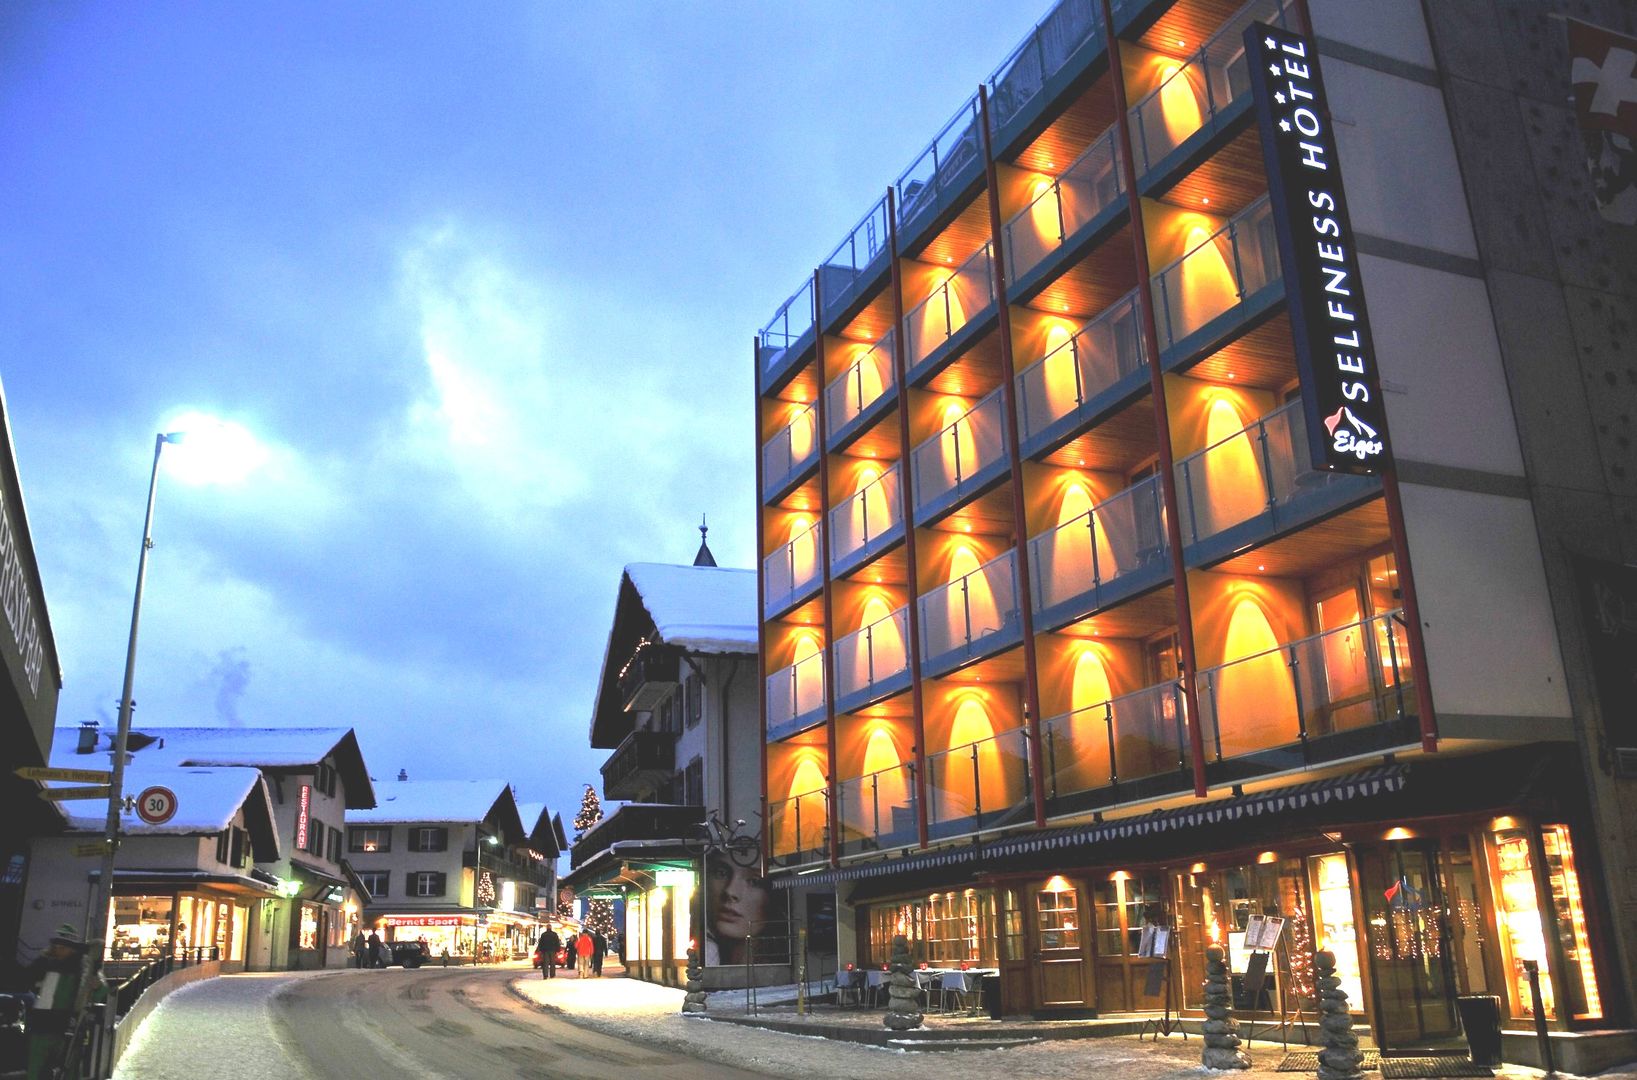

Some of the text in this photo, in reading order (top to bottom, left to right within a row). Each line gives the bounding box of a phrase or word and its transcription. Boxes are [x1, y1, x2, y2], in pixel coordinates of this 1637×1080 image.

[1281, 40, 1370, 403] SELFNESS HOTEL
[1333, 430, 1383, 460] Eiger
[148, 799, 164, 812] 30
[298, 785, 309, 849] RESTAURANT
[388, 917, 460, 928] Bernet Sport
